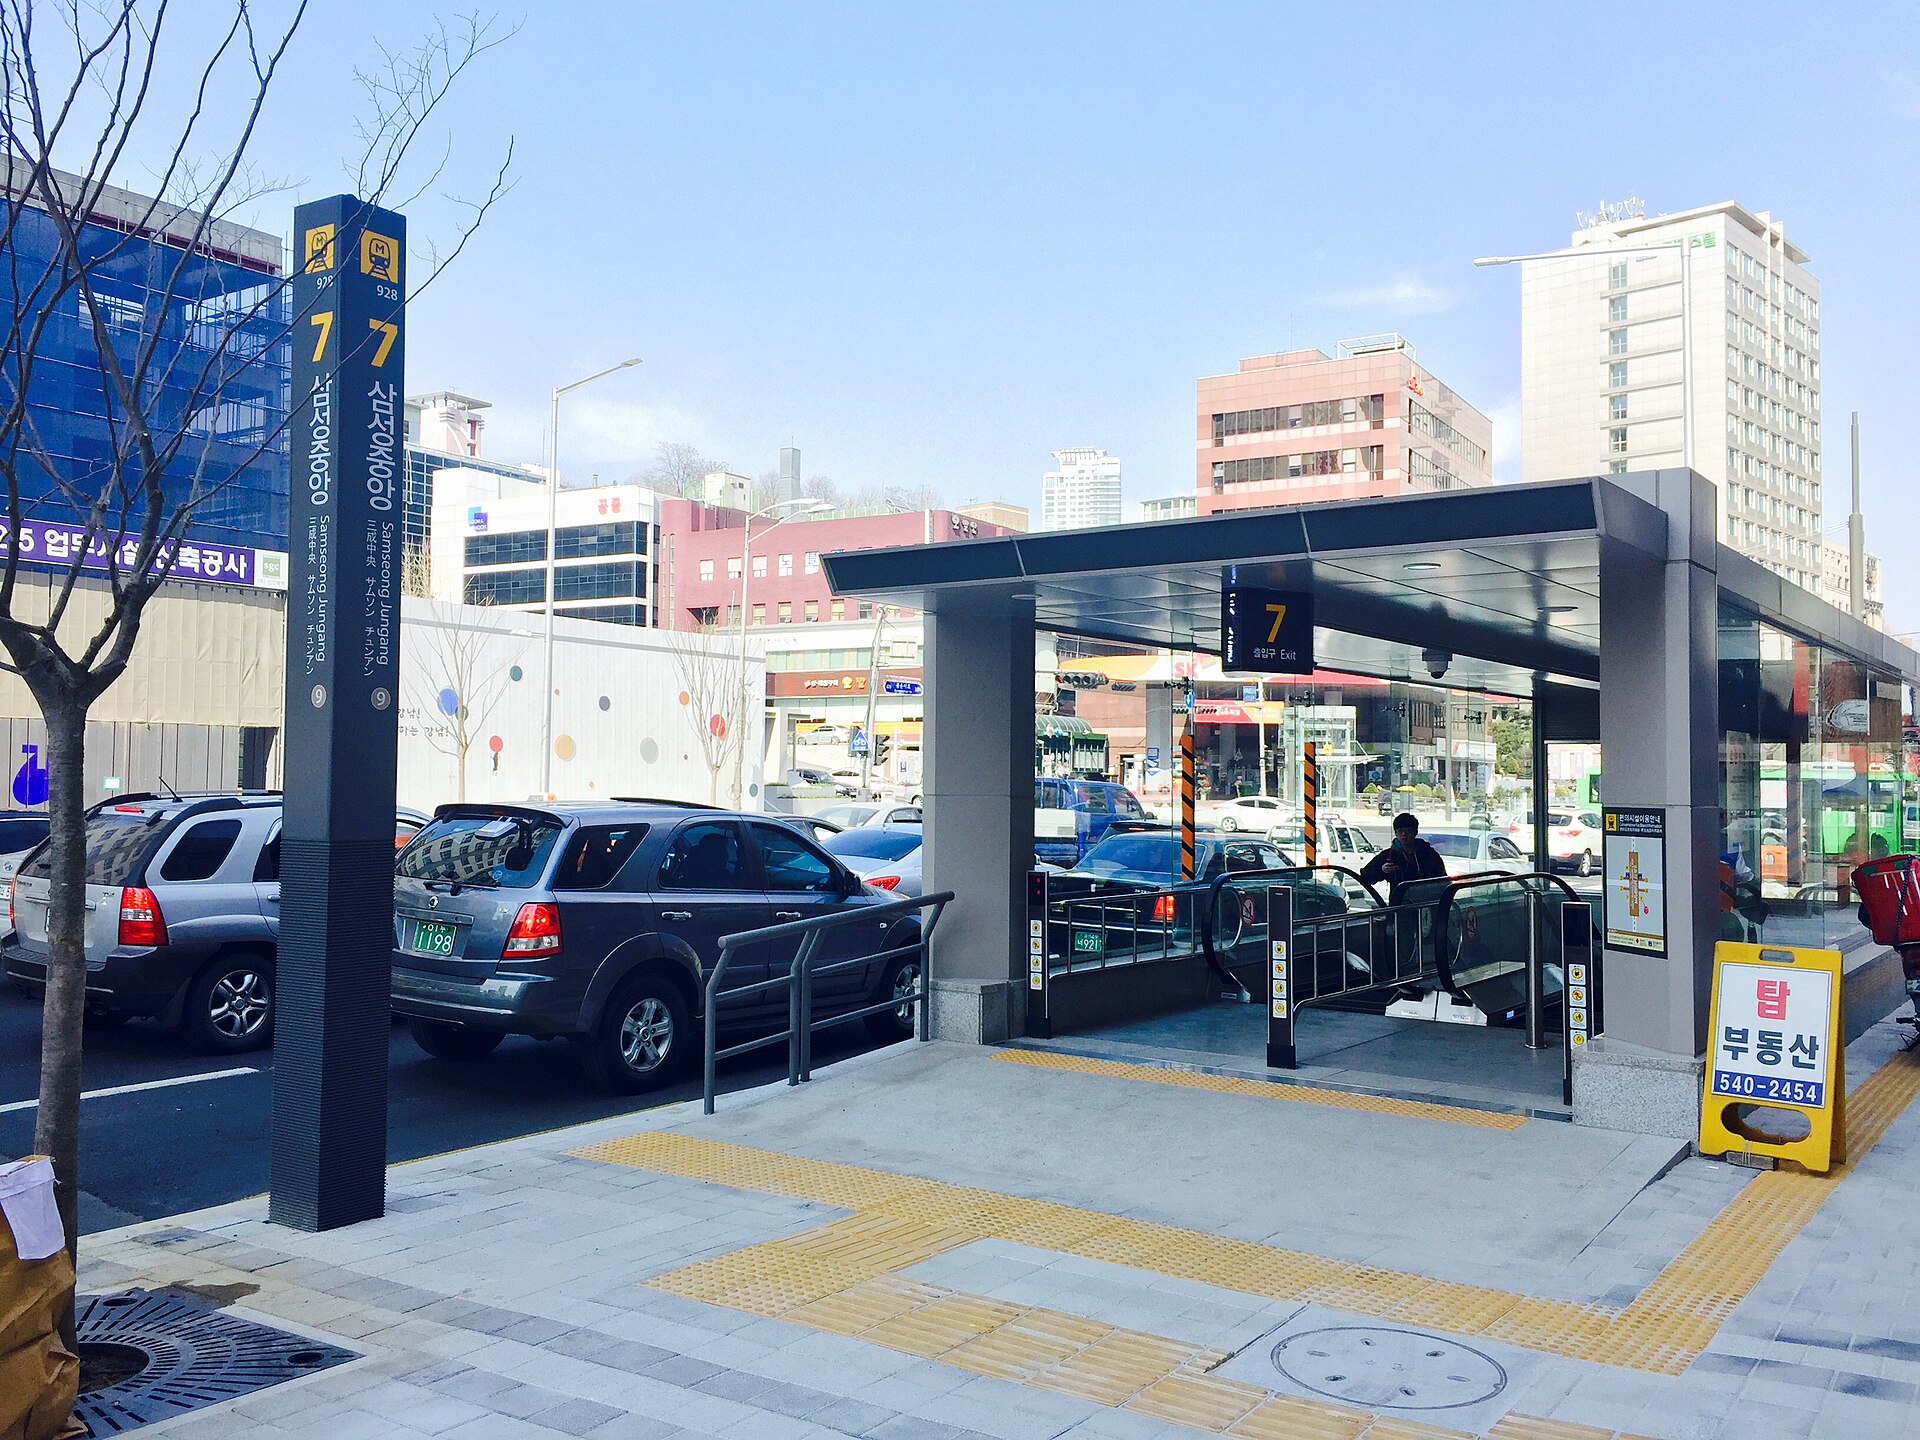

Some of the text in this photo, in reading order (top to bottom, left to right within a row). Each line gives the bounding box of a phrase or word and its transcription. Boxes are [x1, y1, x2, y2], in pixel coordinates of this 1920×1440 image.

[376, 285, 398, 300] 928
[310, 311, 334, 362] 7
[369, 318, 398, 368] 7
[308, 372, 333, 505] 삼성중앙
[366, 381, 398, 511] 삼성중앙
[315, 515, 330, 662] Samseong Jungang
[376, 522, 394, 665] Samseong Jungang
[1265, 603, 1287, 643] 7
[1174, 661, 1198, 679] SK
[1253, 647, 1297, 661] 출입구 Exit
[417, 931, 452, 952] 1198
[1756, 978, 1791, 1021] 탑
[1722, 1026, 1820, 1070] 부동산
[1719, 1073, 1818, 1103] 540-2454
